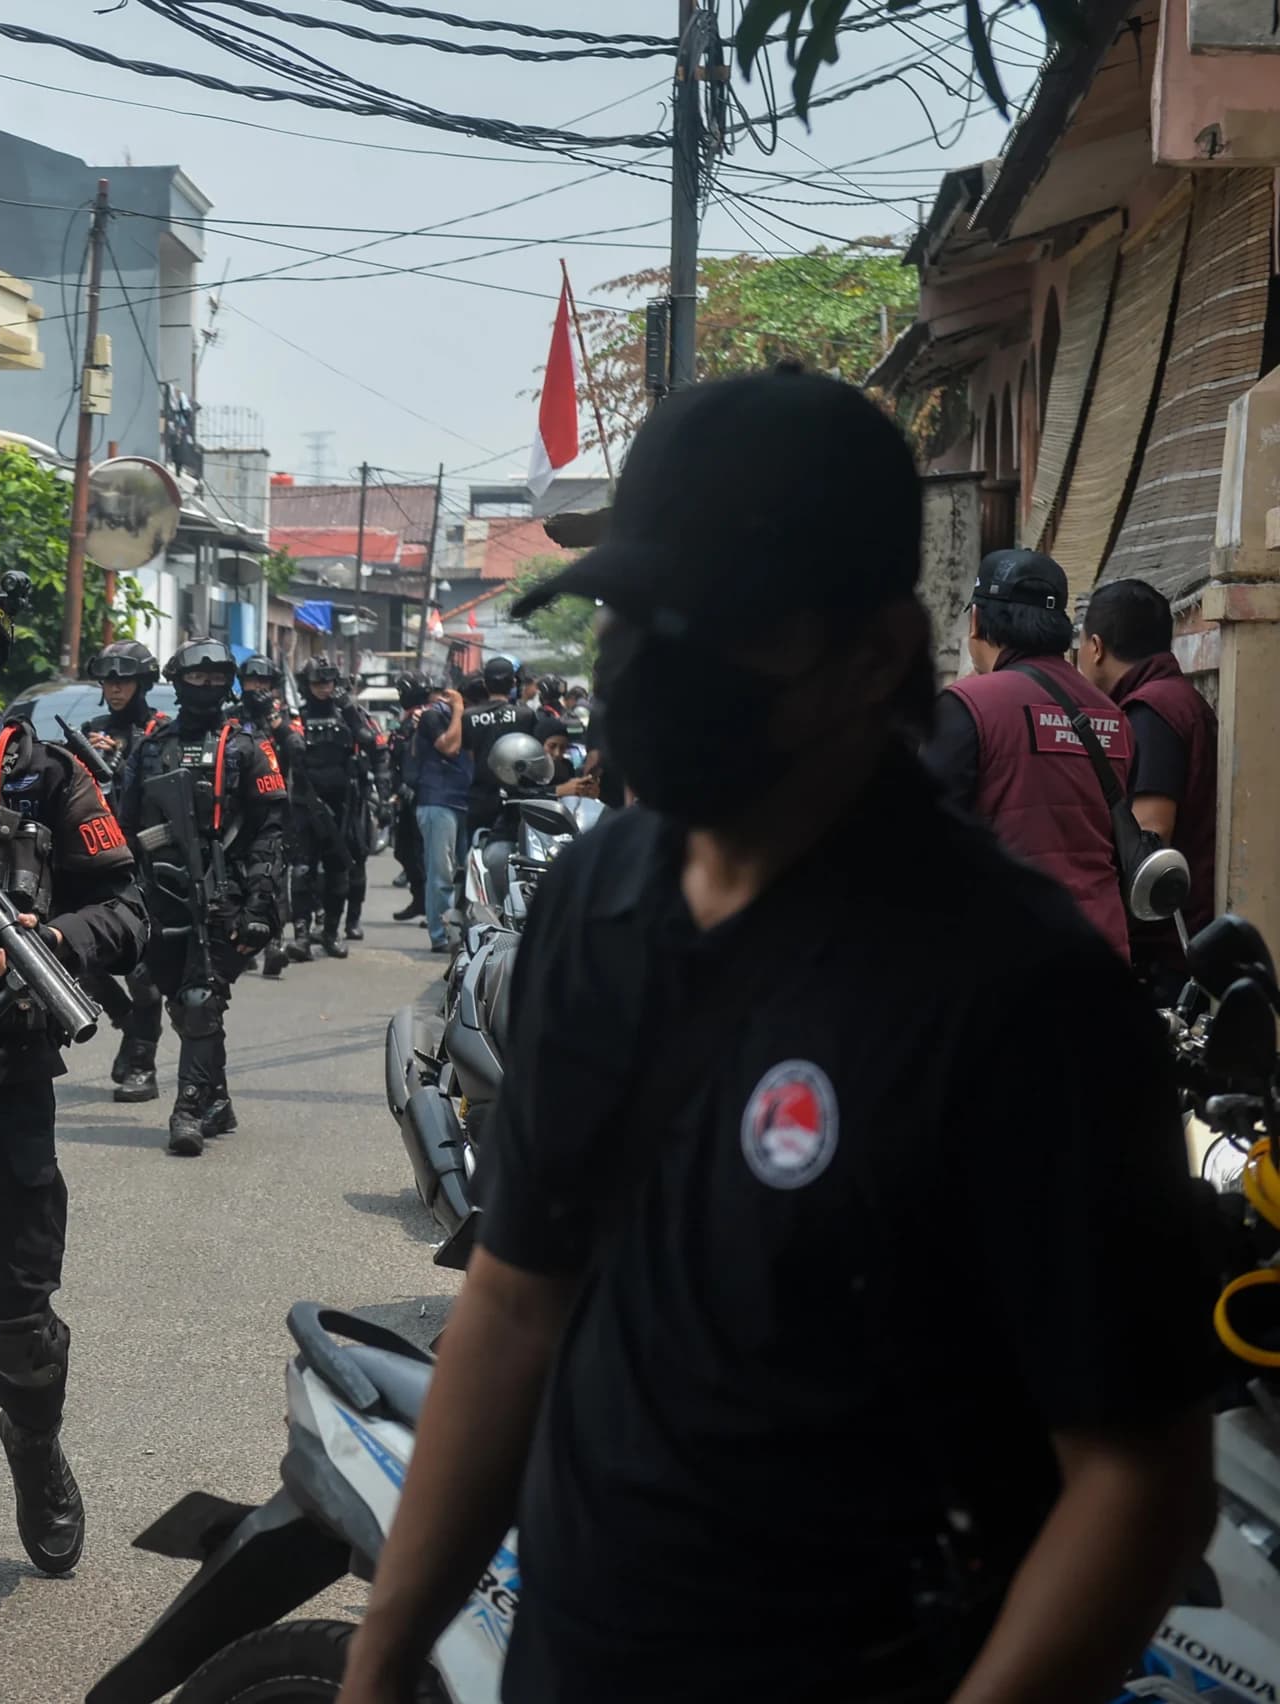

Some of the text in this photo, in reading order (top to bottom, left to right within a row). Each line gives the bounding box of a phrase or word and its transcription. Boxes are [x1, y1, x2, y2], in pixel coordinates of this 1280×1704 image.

[1039, 713, 1119, 732] NARTIC
[1055, 730, 1112, 748] POLE
[1160, 1624, 1277, 1703] HONDA
